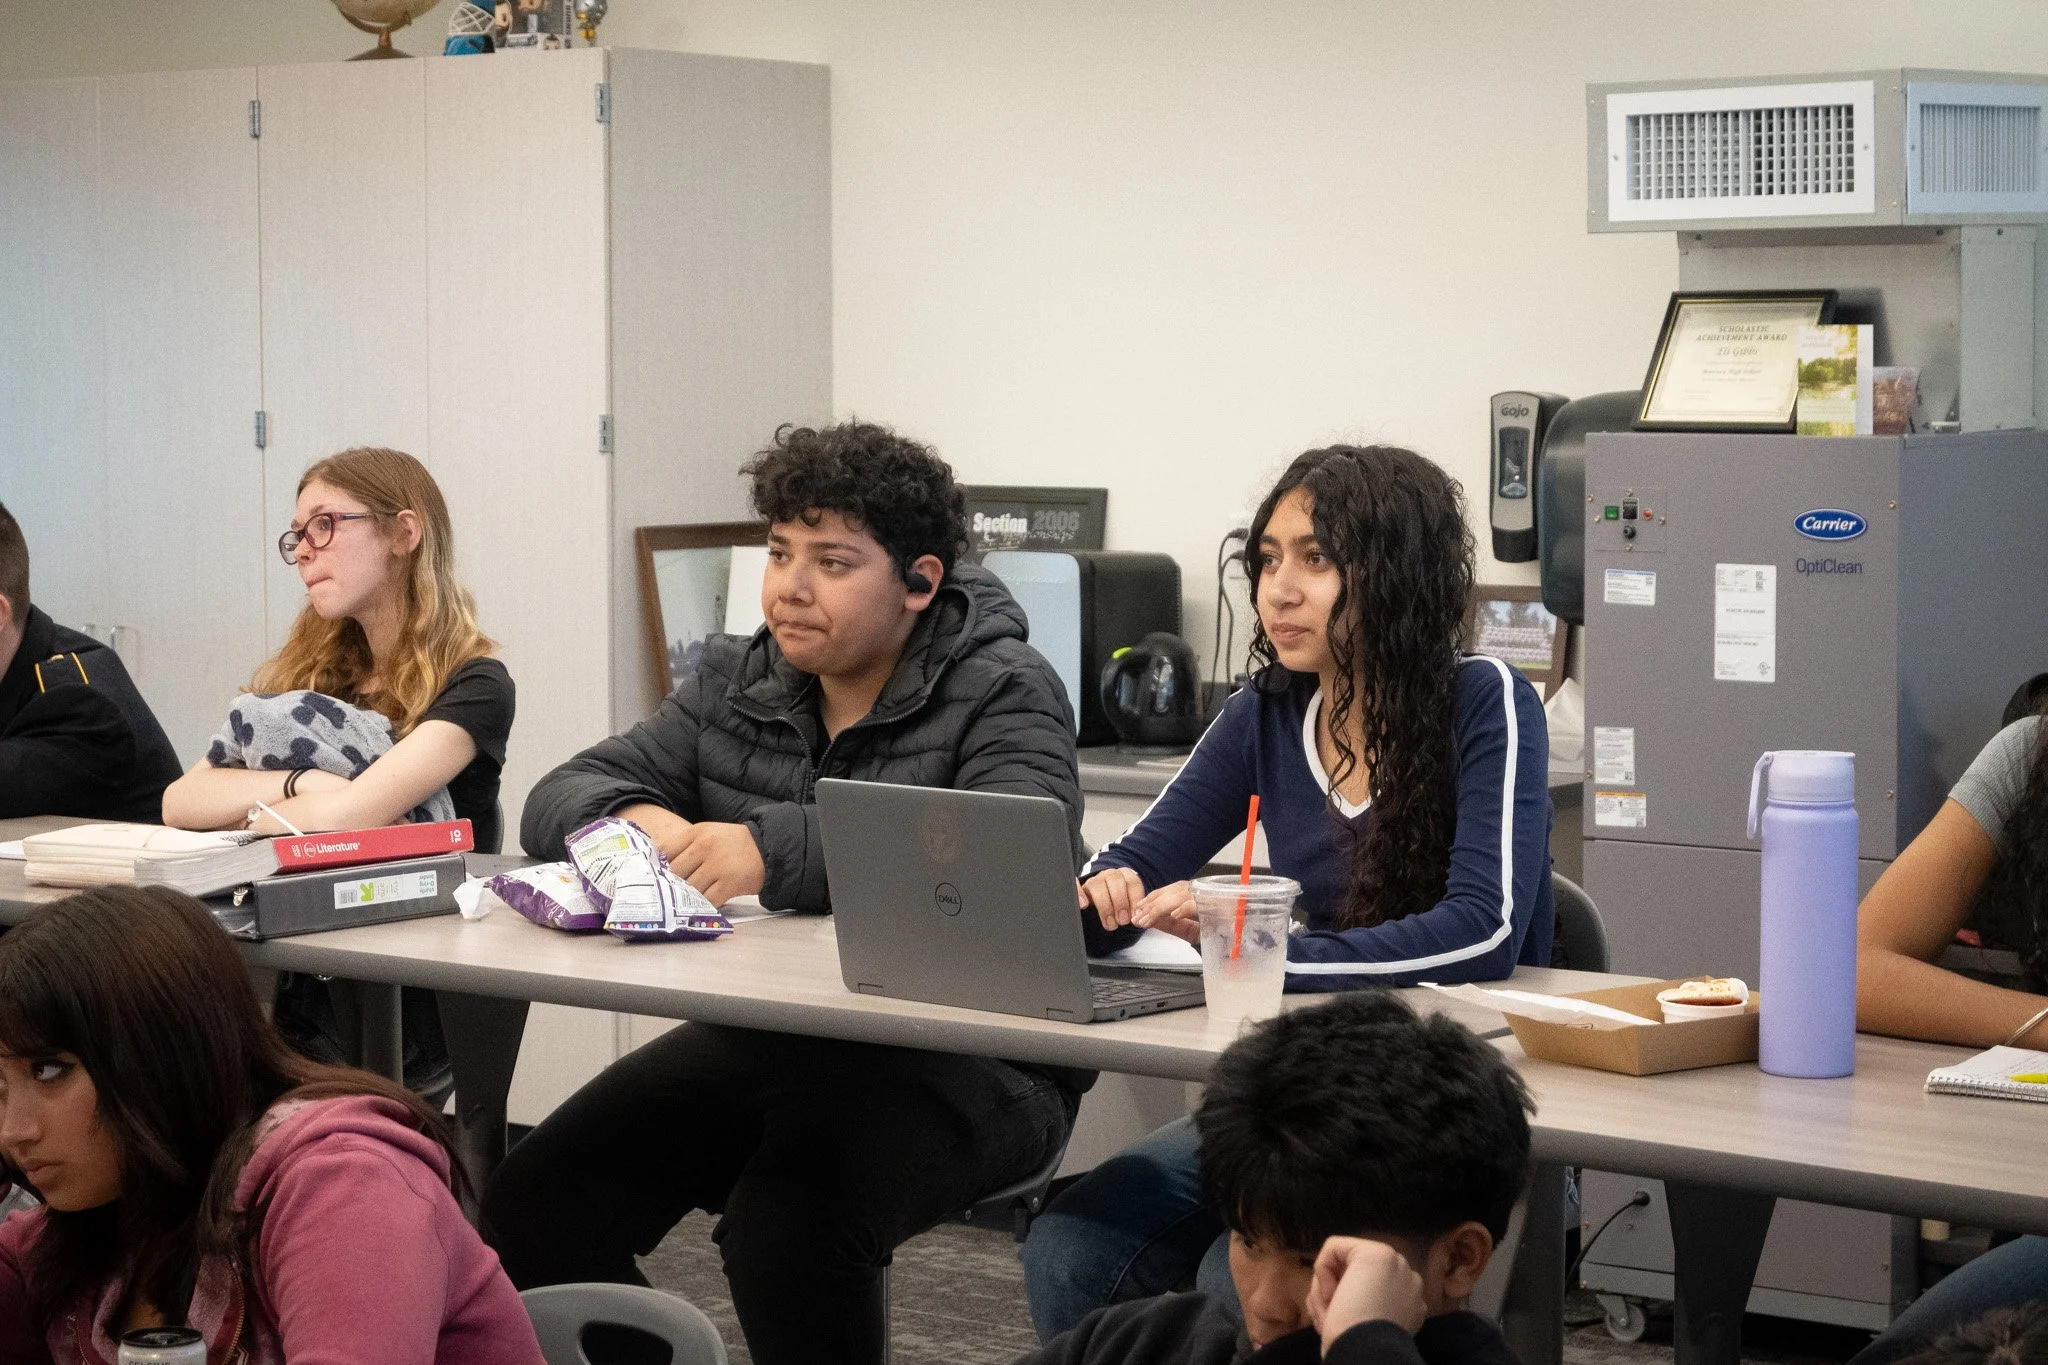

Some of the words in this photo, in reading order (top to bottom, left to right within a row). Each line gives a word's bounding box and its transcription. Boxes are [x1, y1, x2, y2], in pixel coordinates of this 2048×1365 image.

[1718, 325, 1770, 333] SCHOLASTIC
[1696, 333, 1755, 342] ACHIEVEMENT
[1756, 333, 1788, 342] AWARD
[973, 512, 1028, 533] Section
[1033, 510, 1080, 532] 2006
[1802, 516, 1857, 531] Carrier
[1796, 558, 1863, 576] OptiClean
[453, 829, 462, 842] 10
[315, 842, 360, 855] Literature
[938, 894, 959, 905] DELL
